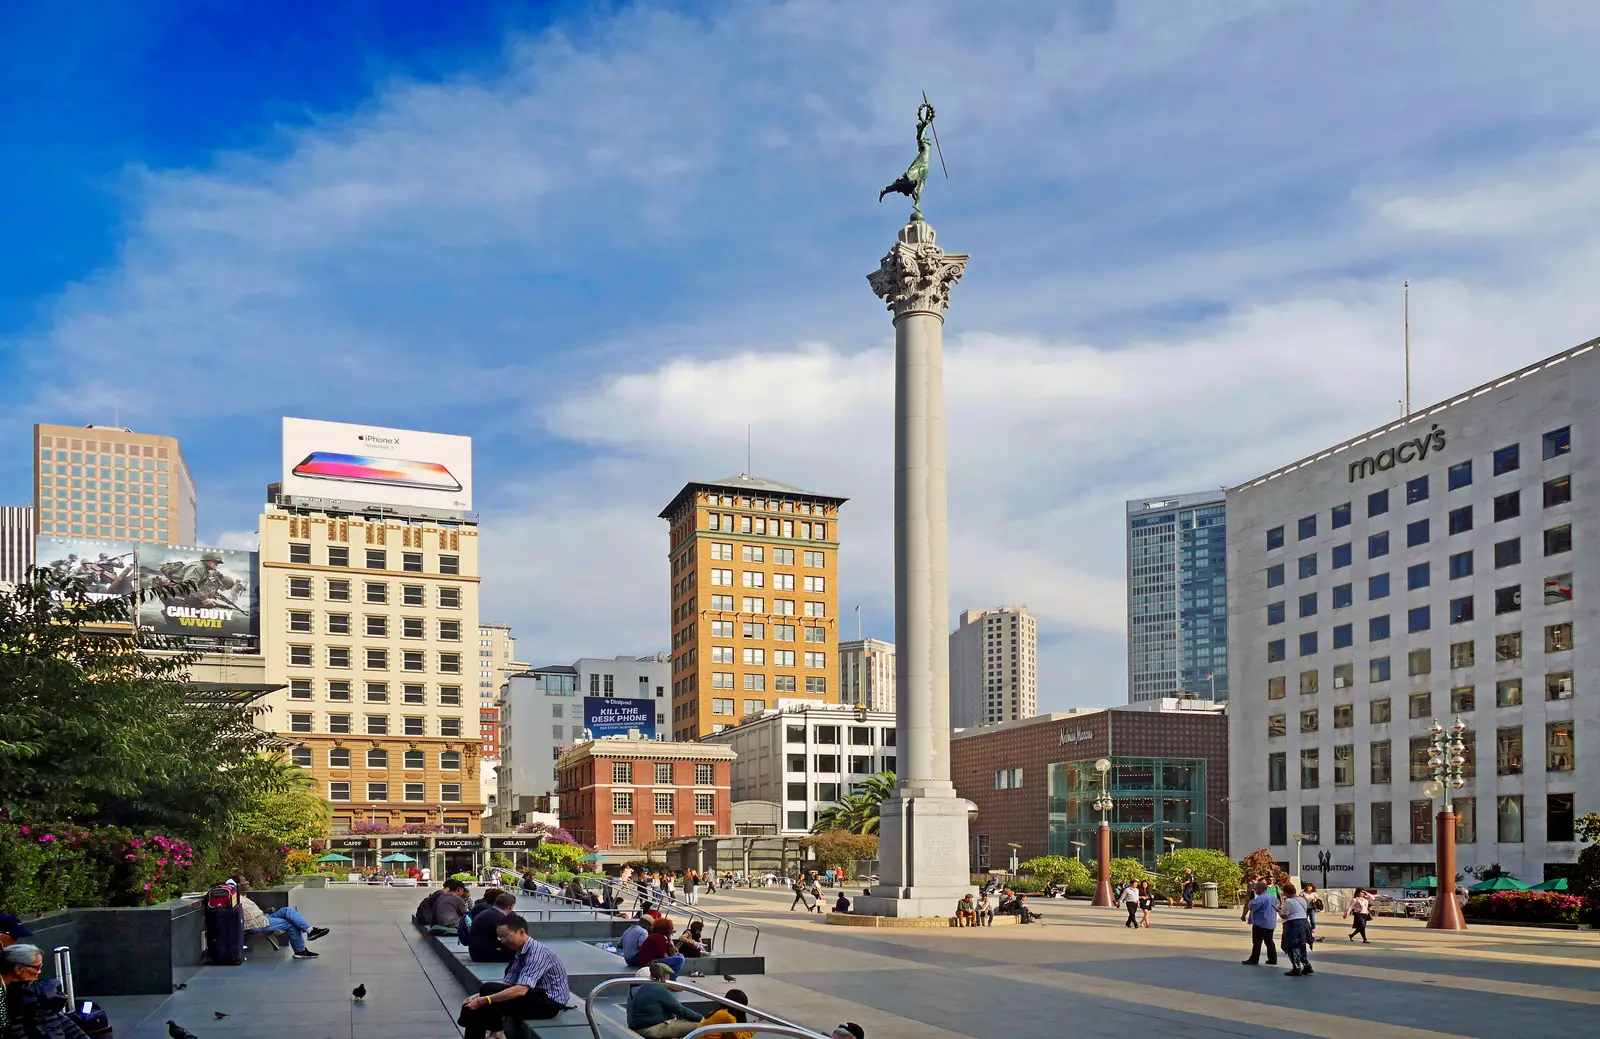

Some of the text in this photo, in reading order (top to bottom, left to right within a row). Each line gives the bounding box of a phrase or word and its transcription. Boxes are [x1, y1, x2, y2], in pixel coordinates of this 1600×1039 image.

[365, 435, 393, 444] iPhone
[1348, 423, 1446, 483] macy's
[166, 605, 234, 620] CALL DUTY
[179, 617, 223, 628] WWII
[1406, 890, 1427, 899] FedEx
